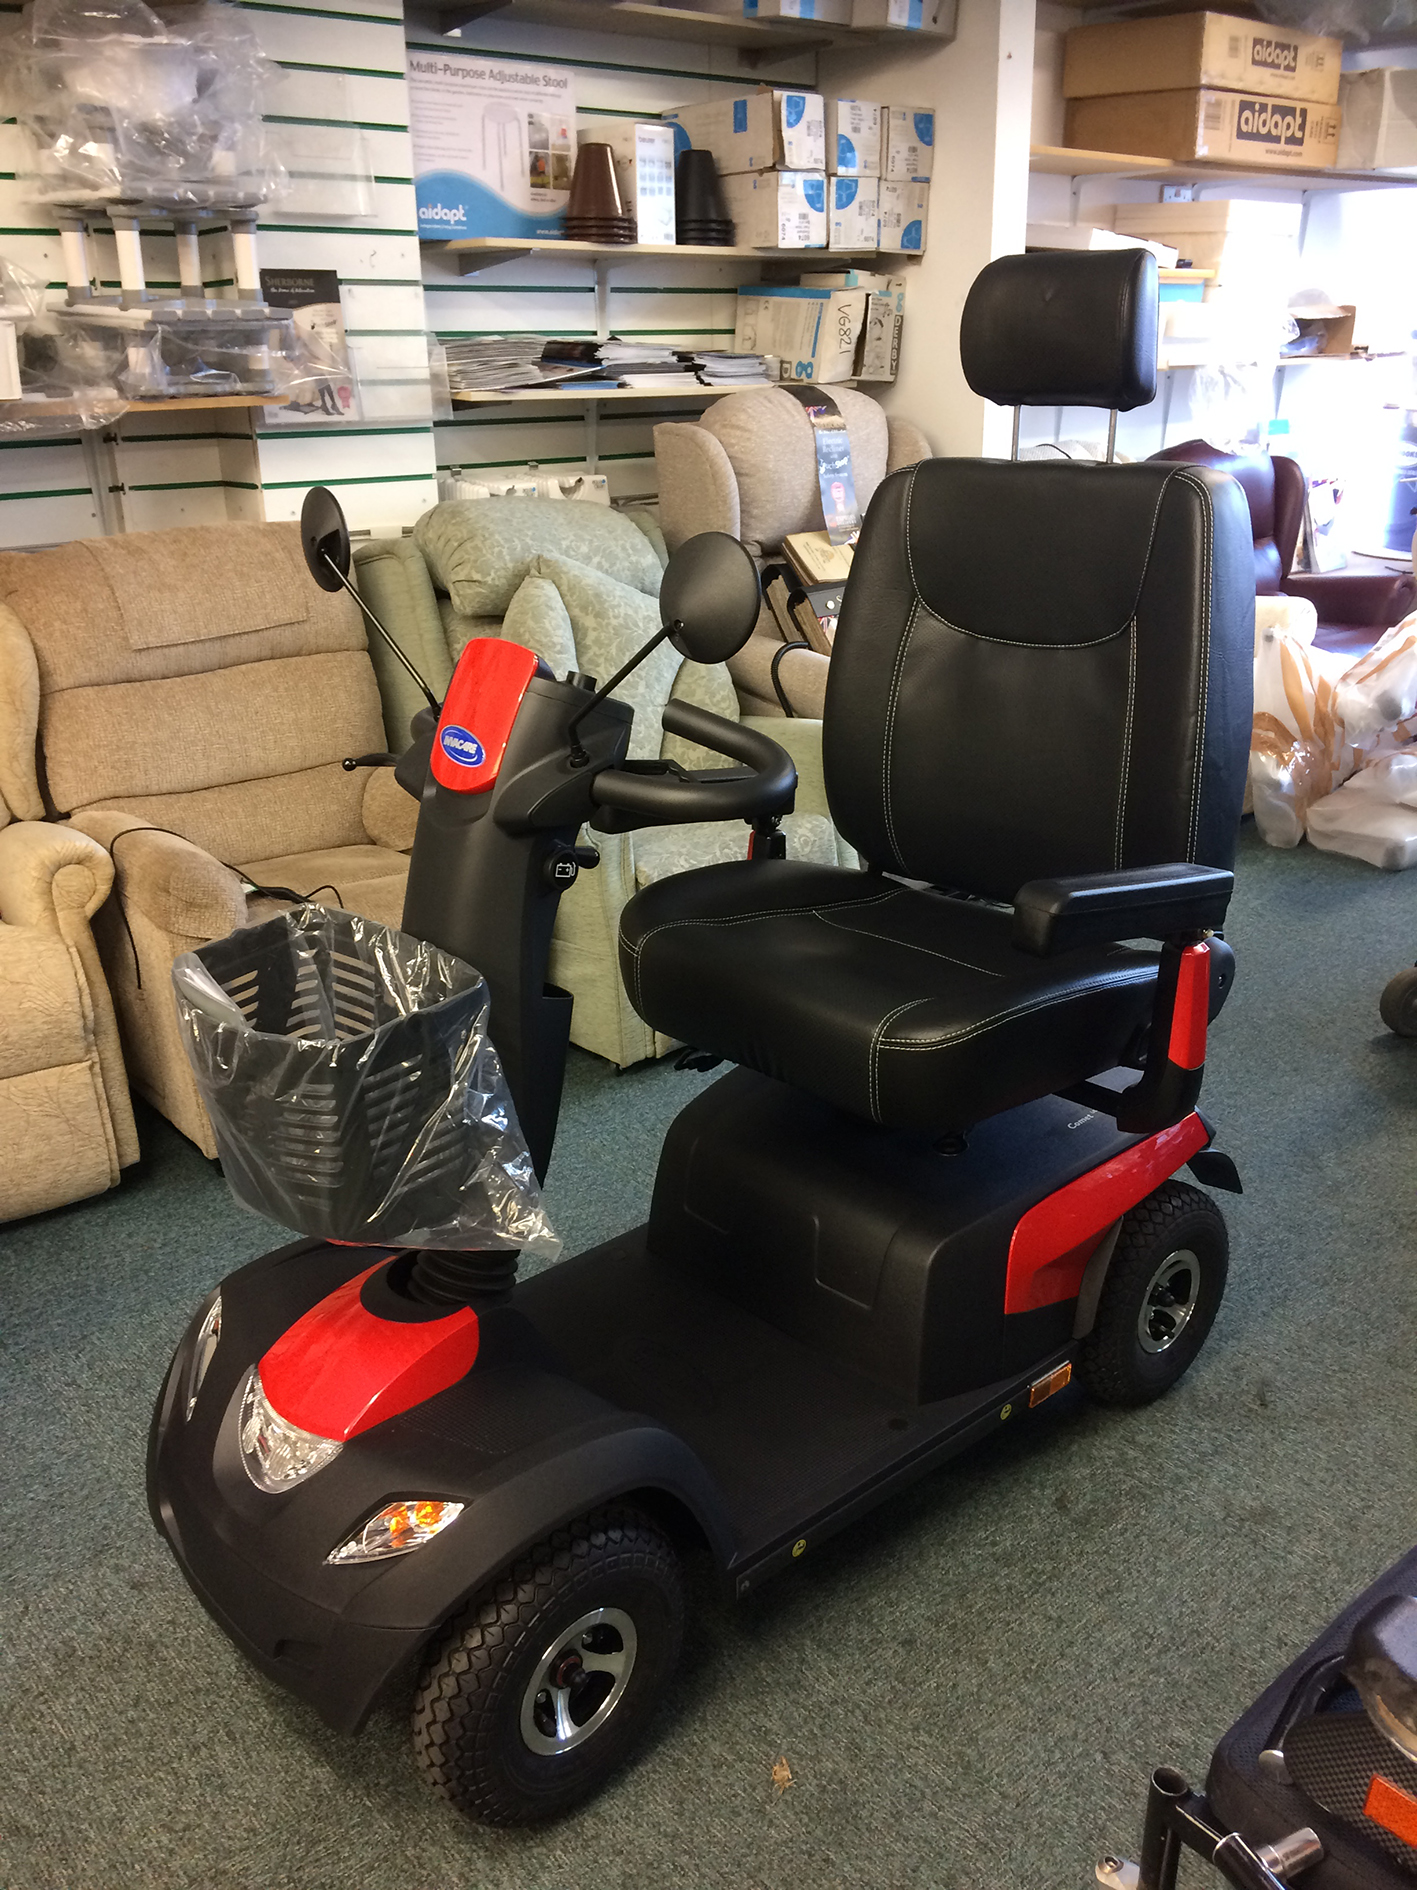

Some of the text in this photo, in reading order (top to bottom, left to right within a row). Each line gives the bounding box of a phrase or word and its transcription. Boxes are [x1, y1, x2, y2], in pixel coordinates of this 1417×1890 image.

[1253, 40, 1296, 70] aidapt
[409, 60, 568, 89] Multi-Purpose Adjustable Stool
[1240, 102, 1304, 145] aidapt
[418, 203, 467, 225] aidapt
[837, 304, 852, 354] VG821
[890, 316, 903, 371] DERBY
[1067, 1114, 1094, 1129] Comet
